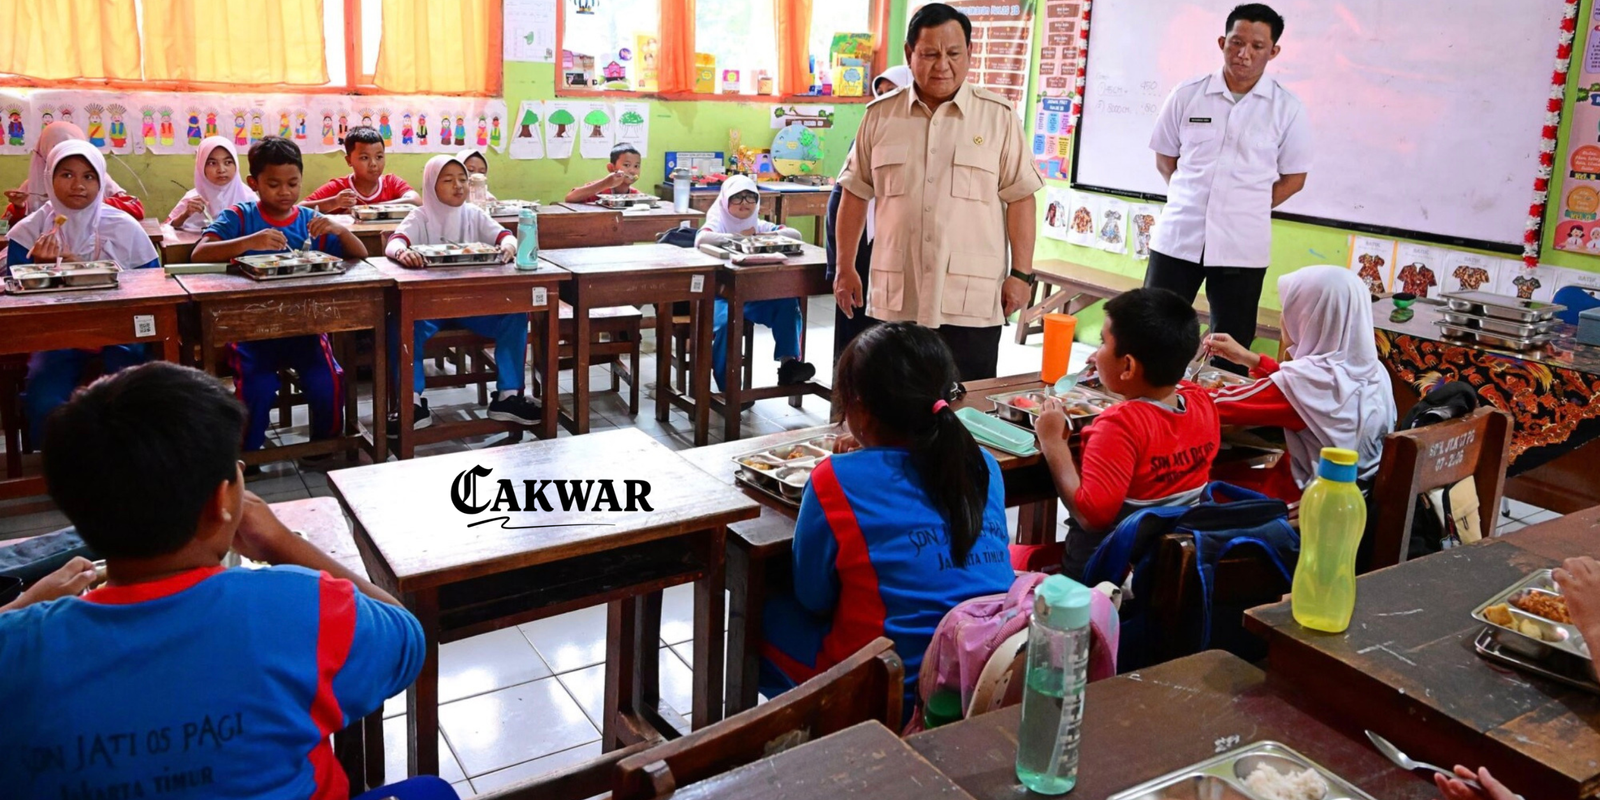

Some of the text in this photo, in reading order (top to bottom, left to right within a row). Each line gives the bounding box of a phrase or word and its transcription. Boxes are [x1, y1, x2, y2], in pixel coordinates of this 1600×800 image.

[908, 528, 938, 557] SDN
[74, 732, 138, 773] JATI
[183, 711, 244, 752] PAGI
